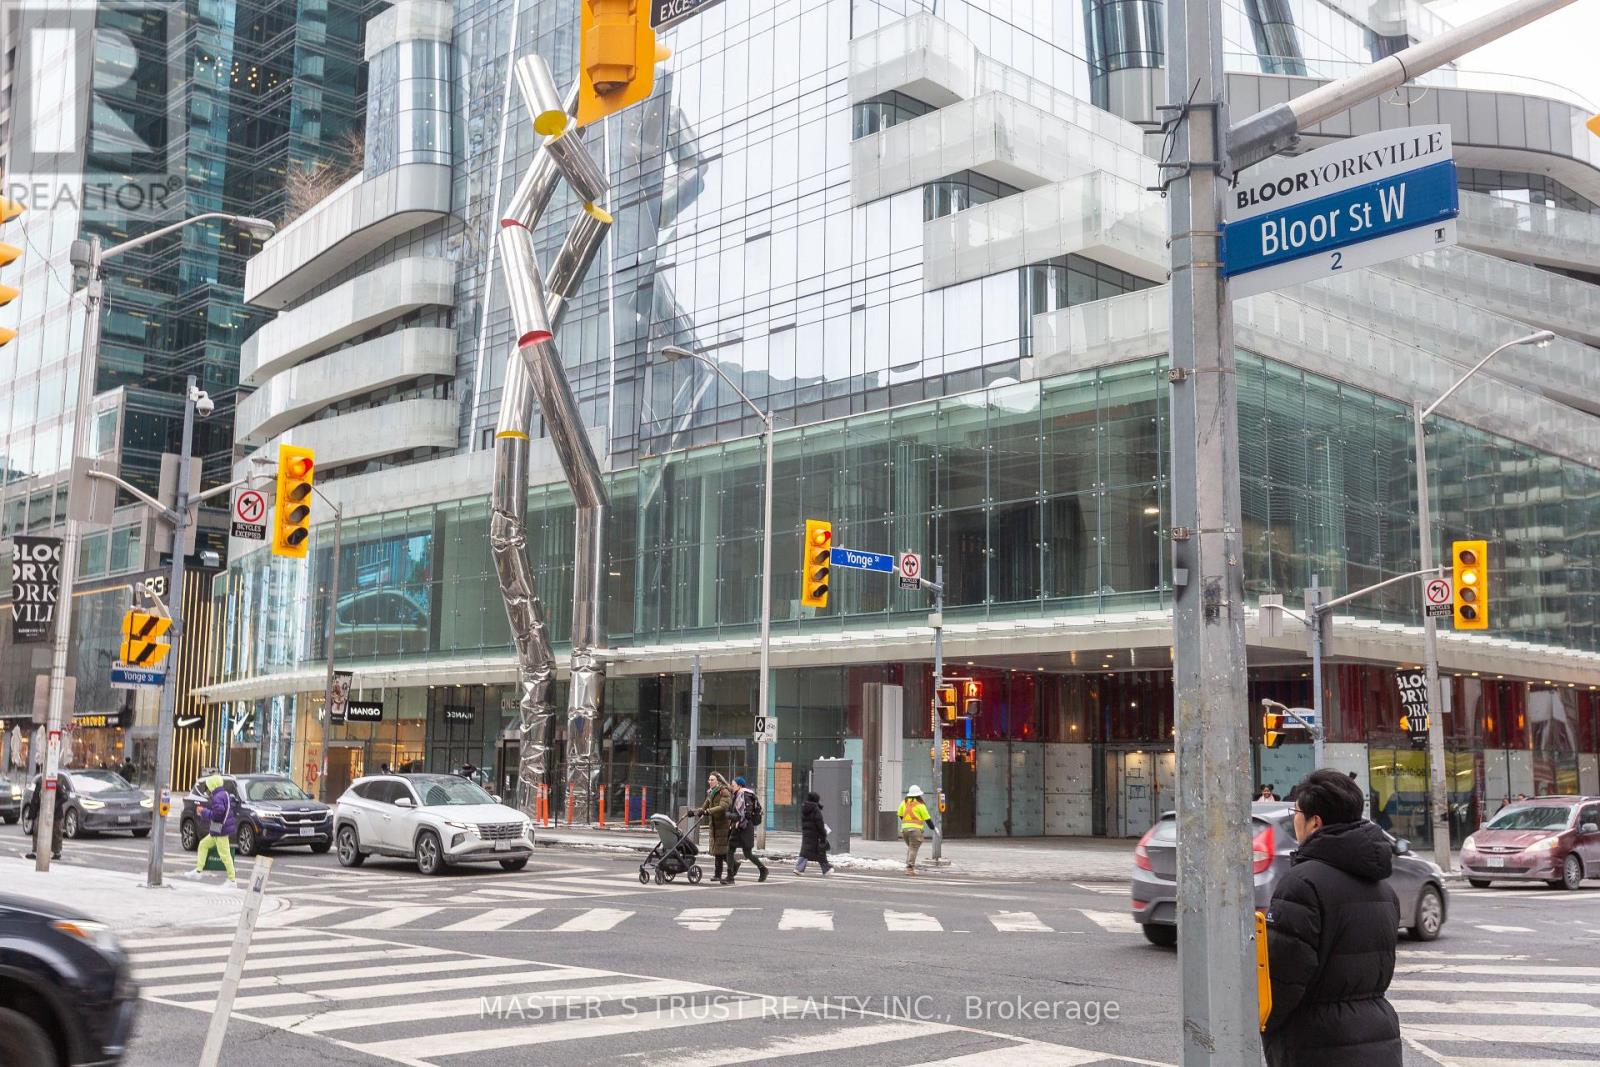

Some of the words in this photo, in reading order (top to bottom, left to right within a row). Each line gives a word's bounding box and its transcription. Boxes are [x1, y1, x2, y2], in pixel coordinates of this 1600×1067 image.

[1237, 131, 1443, 209] BLOORYORKVILLE
[1261, 208, 1340, 256] Bloor
[1349, 203, 1373, 232] St
[1379, 182, 1406, 223] W
[1330, 252, 1342, 270] 2
[846, 551, 873, 568] Yonge
[124, 671, 146, 682] Yonge
[350, 707, 381, 716] MANGO
